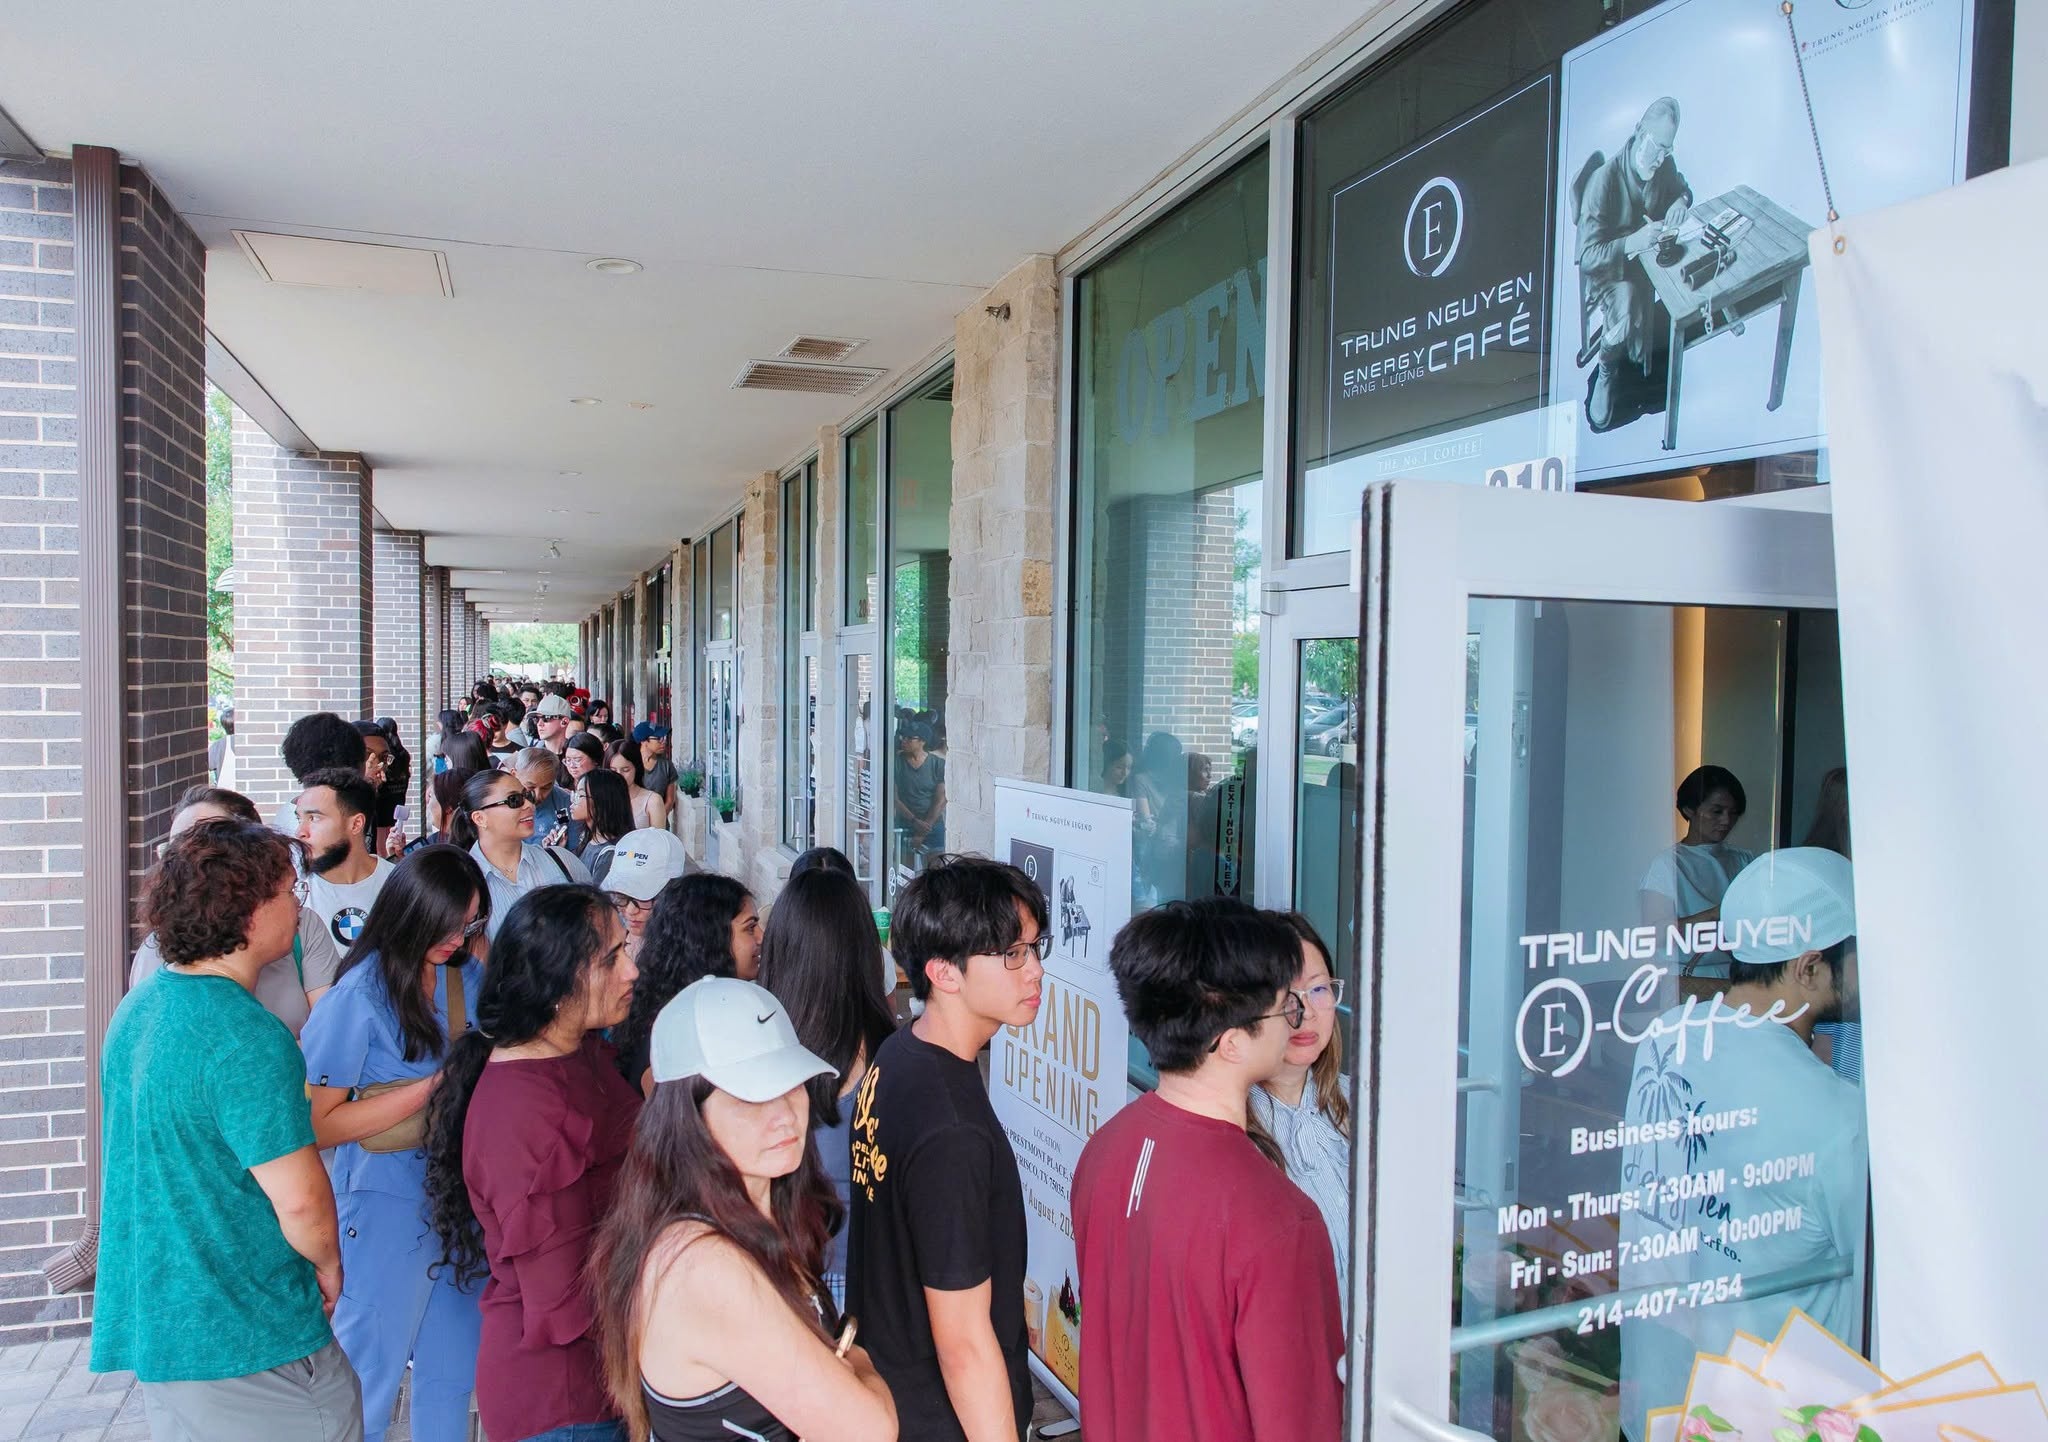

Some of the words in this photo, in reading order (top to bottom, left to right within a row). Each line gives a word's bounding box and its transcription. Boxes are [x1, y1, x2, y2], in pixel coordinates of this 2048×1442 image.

[1116, 256, 1268, 445] OPEN
[1341, 317, 1416, 358] TRUNG
[1427, 272, 1532, 330] NGUYEN
[1343, 347, 1425, 386] ENERGY
[1428, 302, 1531, 373] CAFÉ
[1377, 459, 1398, 473] THE
[1224, 784, 1235, 888] EXTINGUISHER
[333, 908, 368, 921] BMW
[1519, 926, 1656, 968] TRUNG
[1666, 914, 1813, 956] NGUYEN
[1005, 982, 1101, 1082] AND
[1004, 1040, 1098, 1139] OPENING
[1570, 1116, 1682, 1154] Business
[1687, 1107, 1759, 1136] hours:
[1498, 1204, 1548, 1235] Mon
[1567, 1189, 1640, 1222] Thurs:
[1645, 1168, 1725, 1207] 7:30AM
[1743, 1152, 1816, 1188] 9:00PM
[1510, 1255, 1542, 1290] Fri
[1561, 1247, 1613, 1279] Sun:
[1618, 1226, 1698, 1267] 7:30AM
[1717, 1206, 1802, 1247] 10:00PM
[1723, 1246, 1742, 1263] co.
[1577, 1273, 1743, 1336] 214-407-7254
